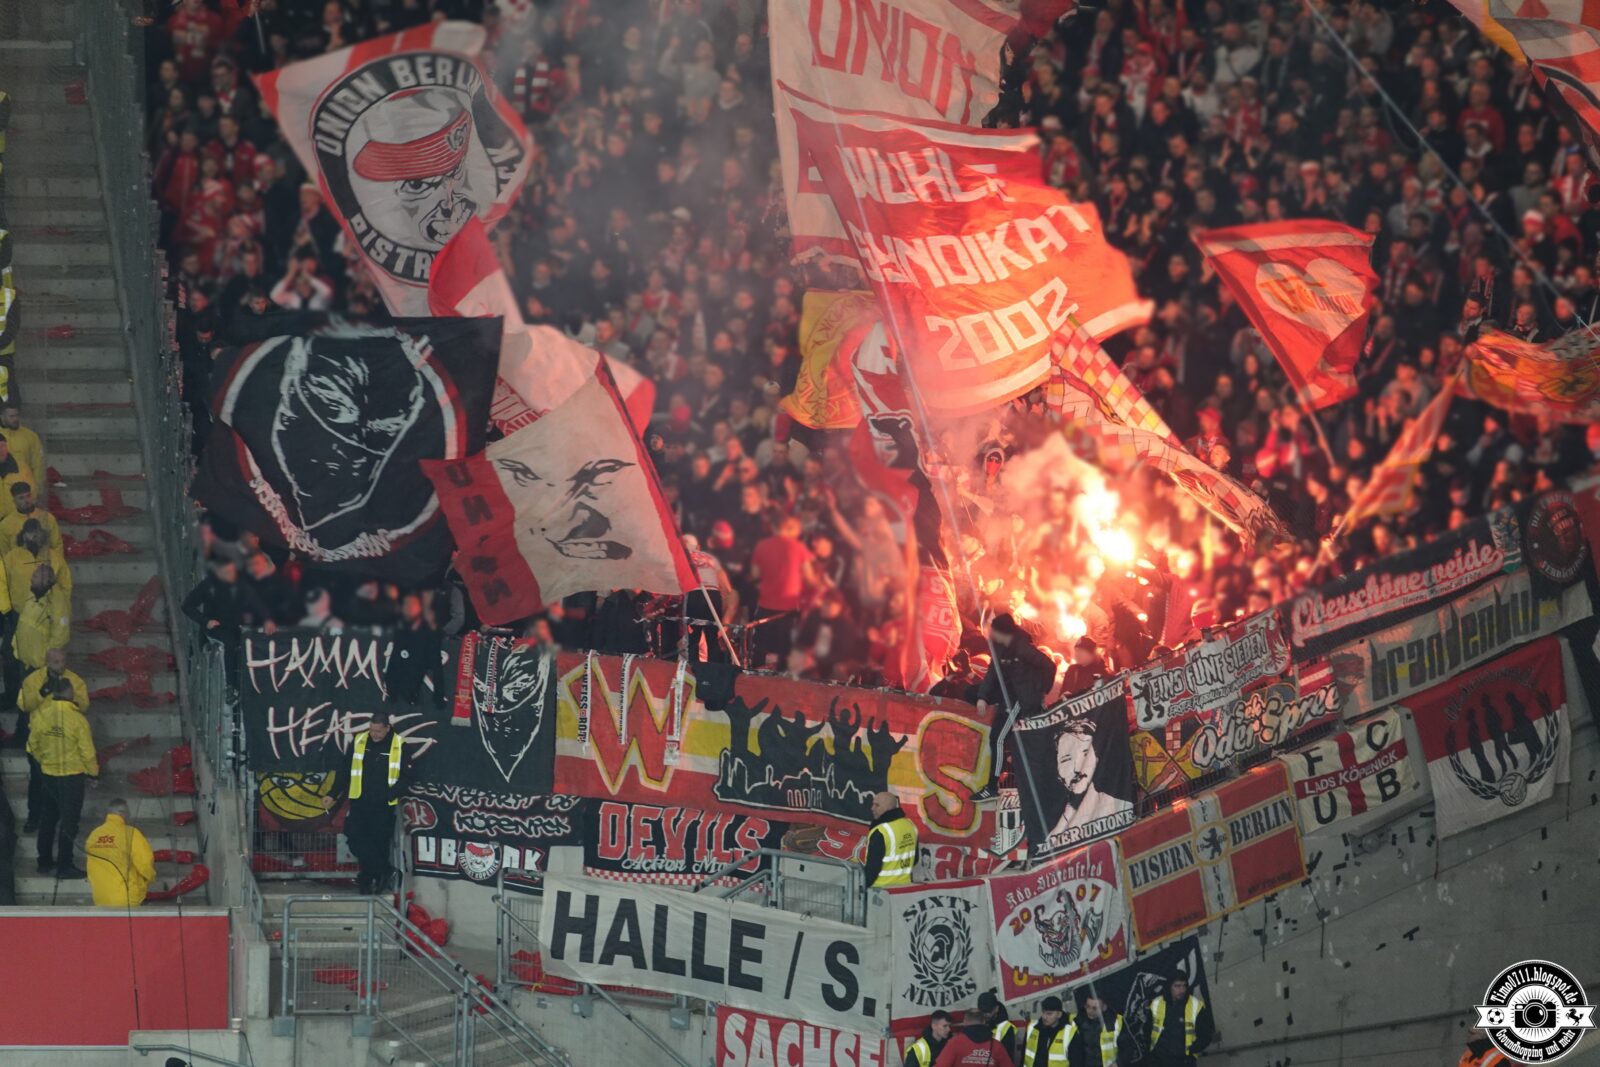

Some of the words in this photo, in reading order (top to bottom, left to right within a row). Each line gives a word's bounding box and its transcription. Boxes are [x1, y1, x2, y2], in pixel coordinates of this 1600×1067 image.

[314, 70, 388, 158] UNION
[927, 276, 1079, 371] 2002
[1292, 539, 1496, 630] Oberschöneweide
[1149, 668, 1185, 706] EINS
[1184, 650, 1225, 694] FÜNF
[1223, 628, 1267, 674] SIEBEN
[1068, 681, 1125, 716] UNIONER
[1192, 713, 1259, 769] Oder
[1302, 746, 1323, 776] F
[1366, 720, 1389, 752] C
[916, 710, 993, 838] S
[1304, 776, 1337, 795] LADS
[1338, 749, 1399, 784] KÖPENICK
[1313, 791, 1338, 825] U
[1375, 767, 1401, 803] B
[453, 810, 571, 838] KÖPENICK
[597, 801, 770, 874] DEVILS
[1128, 840, 1195, 889] EISERN
[1228, 797, 1293, 847] BERLIN
[621, 852, 687, 873] Action
[903, 895, 979, 922] SIXTY
[550, 890, 767, 993] HALLE
[902, 976, 977, 1008] NINERS
